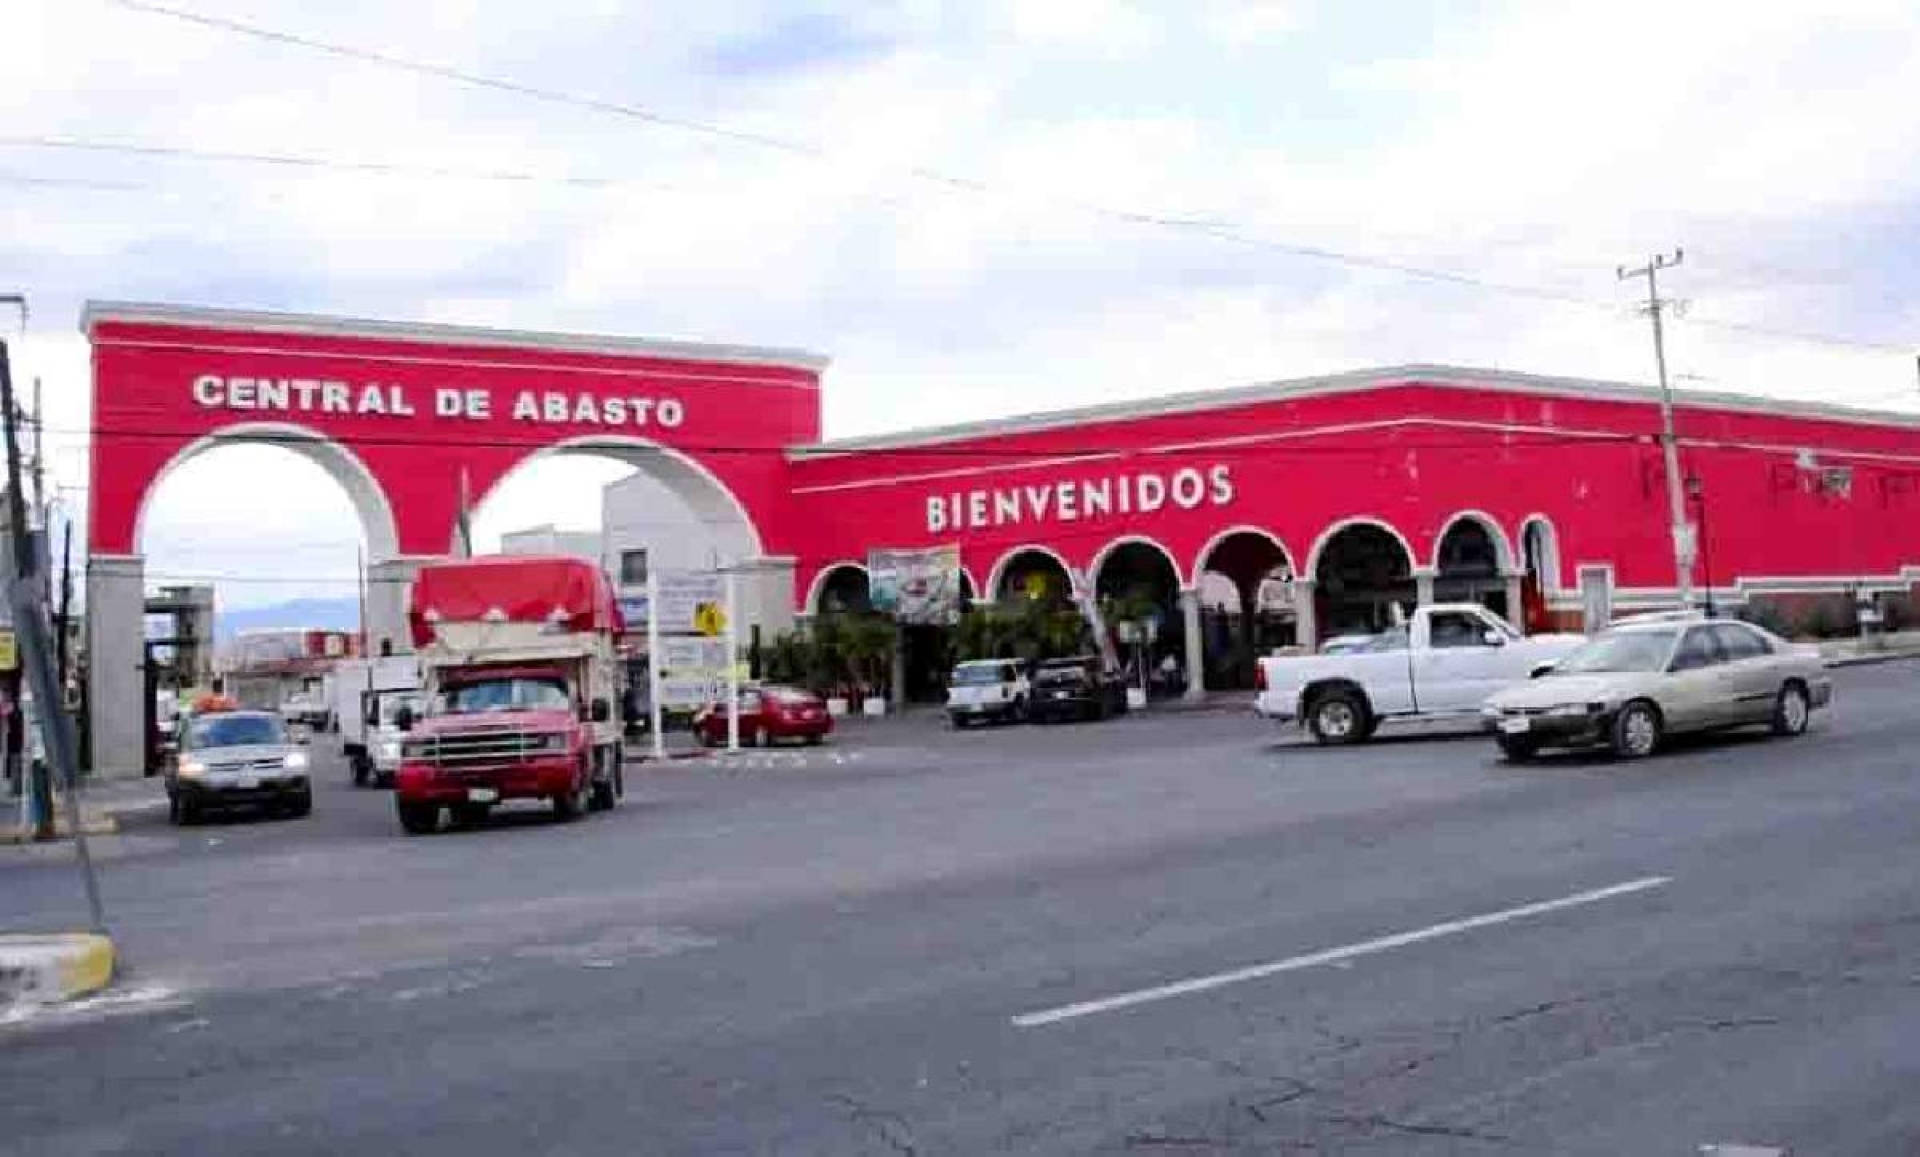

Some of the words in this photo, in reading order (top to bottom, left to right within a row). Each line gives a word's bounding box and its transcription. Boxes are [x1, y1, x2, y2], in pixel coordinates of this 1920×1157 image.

[193, 375, 415, 416] CENTRAL
[435, 388, 491, 419] DE
[512, 391, 684, 427] ABASTO
[926, 465, 1233, 532] BIENVENIDOS
